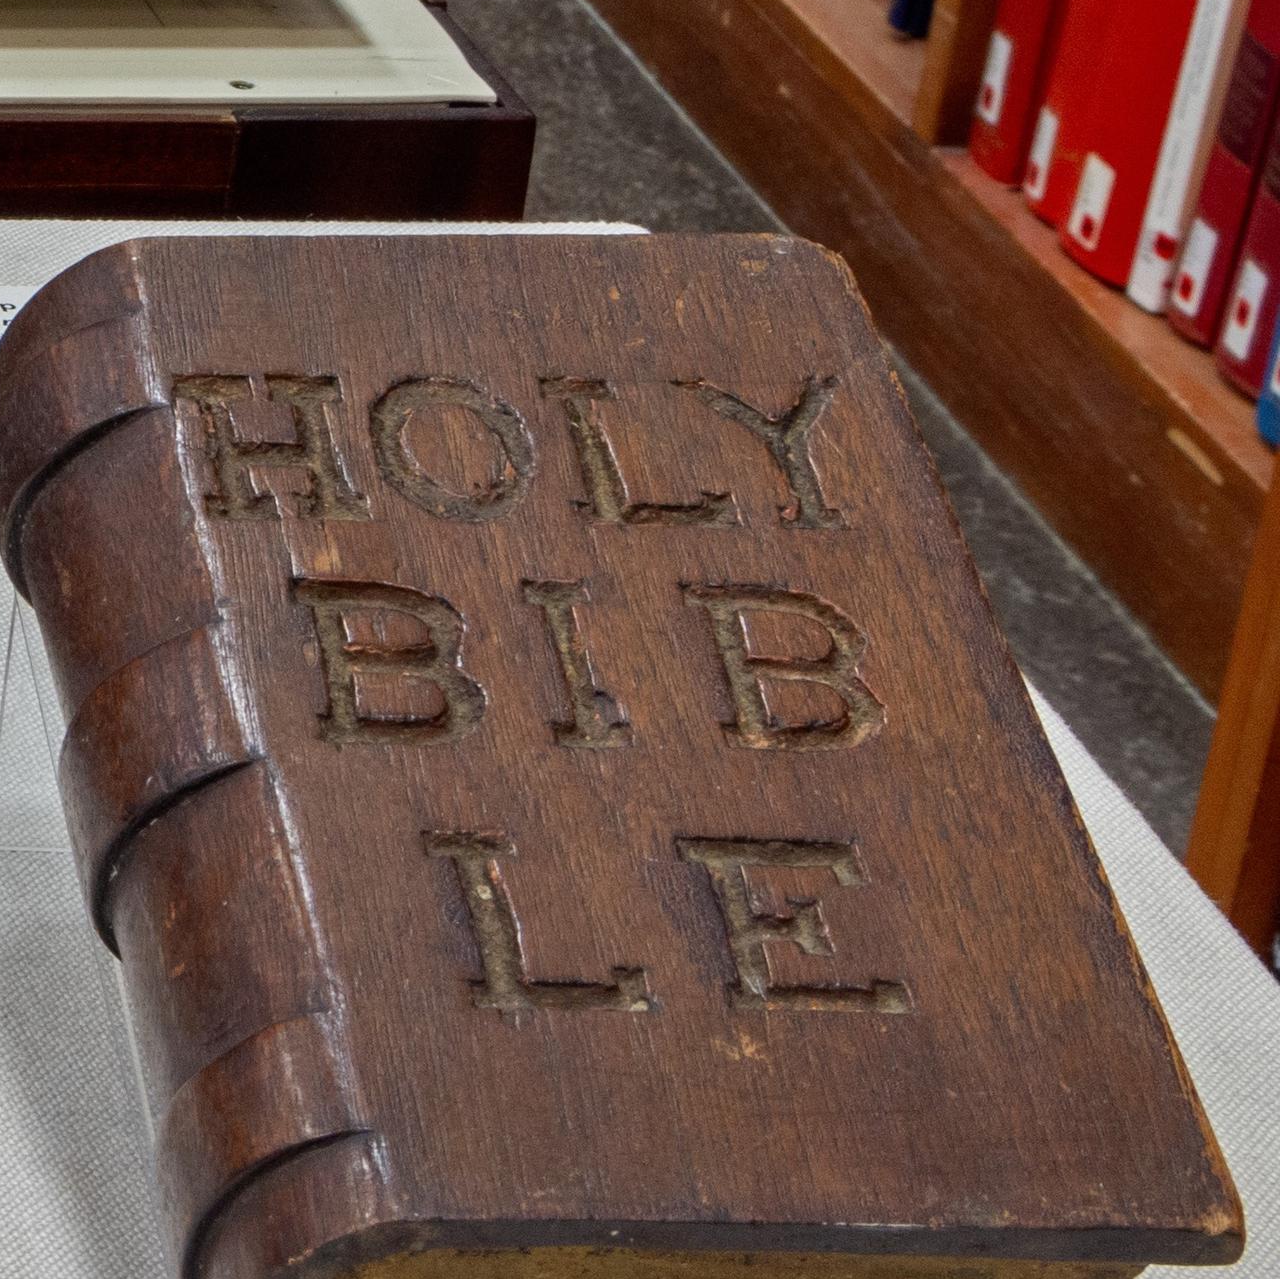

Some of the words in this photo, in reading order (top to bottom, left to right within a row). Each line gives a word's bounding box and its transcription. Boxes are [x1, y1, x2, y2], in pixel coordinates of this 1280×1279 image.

[173, 373, 847, 529] HOLY
[293, 577, 889, 750] BIB
[423, 830, 913, 1014] LE
